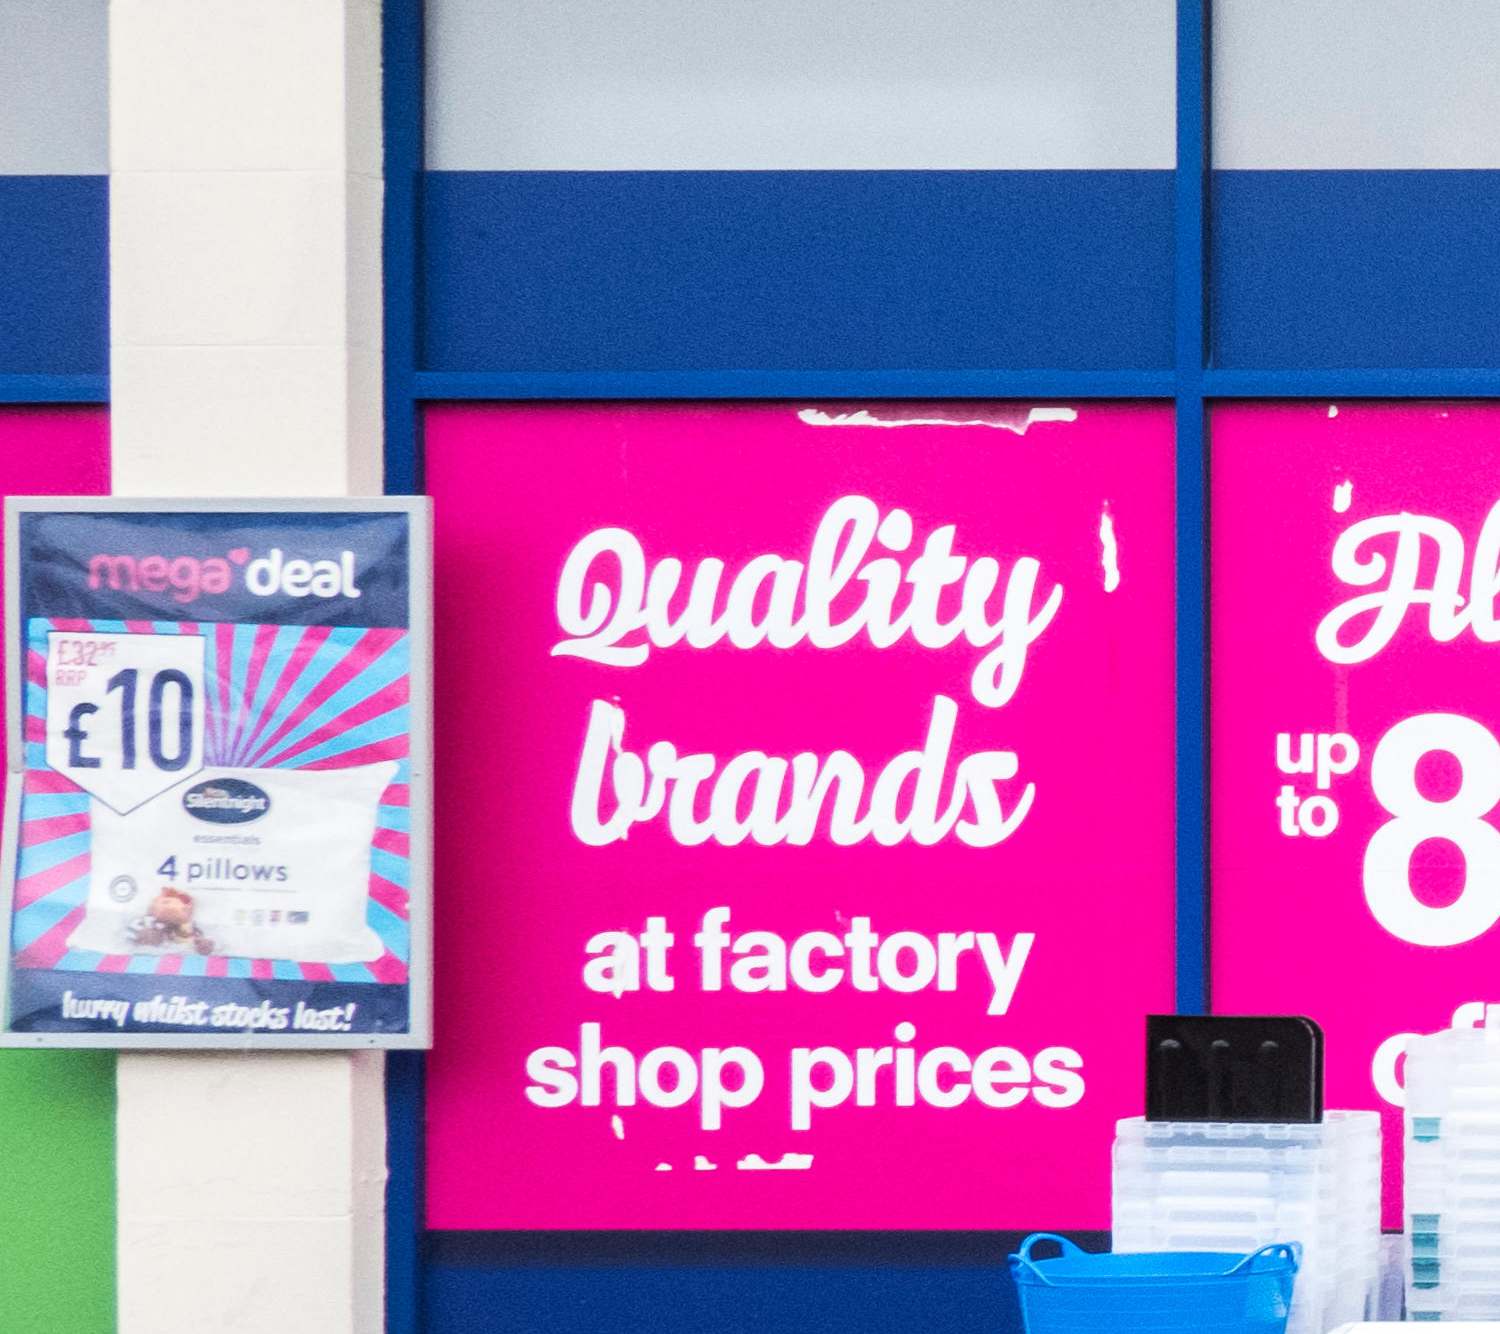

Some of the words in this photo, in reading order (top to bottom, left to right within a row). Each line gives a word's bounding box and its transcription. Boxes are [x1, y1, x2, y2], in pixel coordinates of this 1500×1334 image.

[88, 552, 232, 603] mega
[245, 547, 361, 599] deal
[551, 495, 1063, 708] Quality
[63, 667, 194, 772] £10
[571, 694, 1036, 848] brands
[1276, 732, 1360, 790] up
[1276, 785, 1339, 837] to
[156, 854, 179, 881] 4
[186, 857, 289, 883] pillows
[583, 916, 674, 999] at
[694, 906, 1036, 1016] factory
[62, 990, 131, 1028] hurry
[133, 995, 209, 1026] whilst
[211, 999, 290, 1029] stocks
[293, 1001, 357, 1031] last!
[526, 1022, 765, 1130] shop
[790, 1022, 1085, 1130] prices
